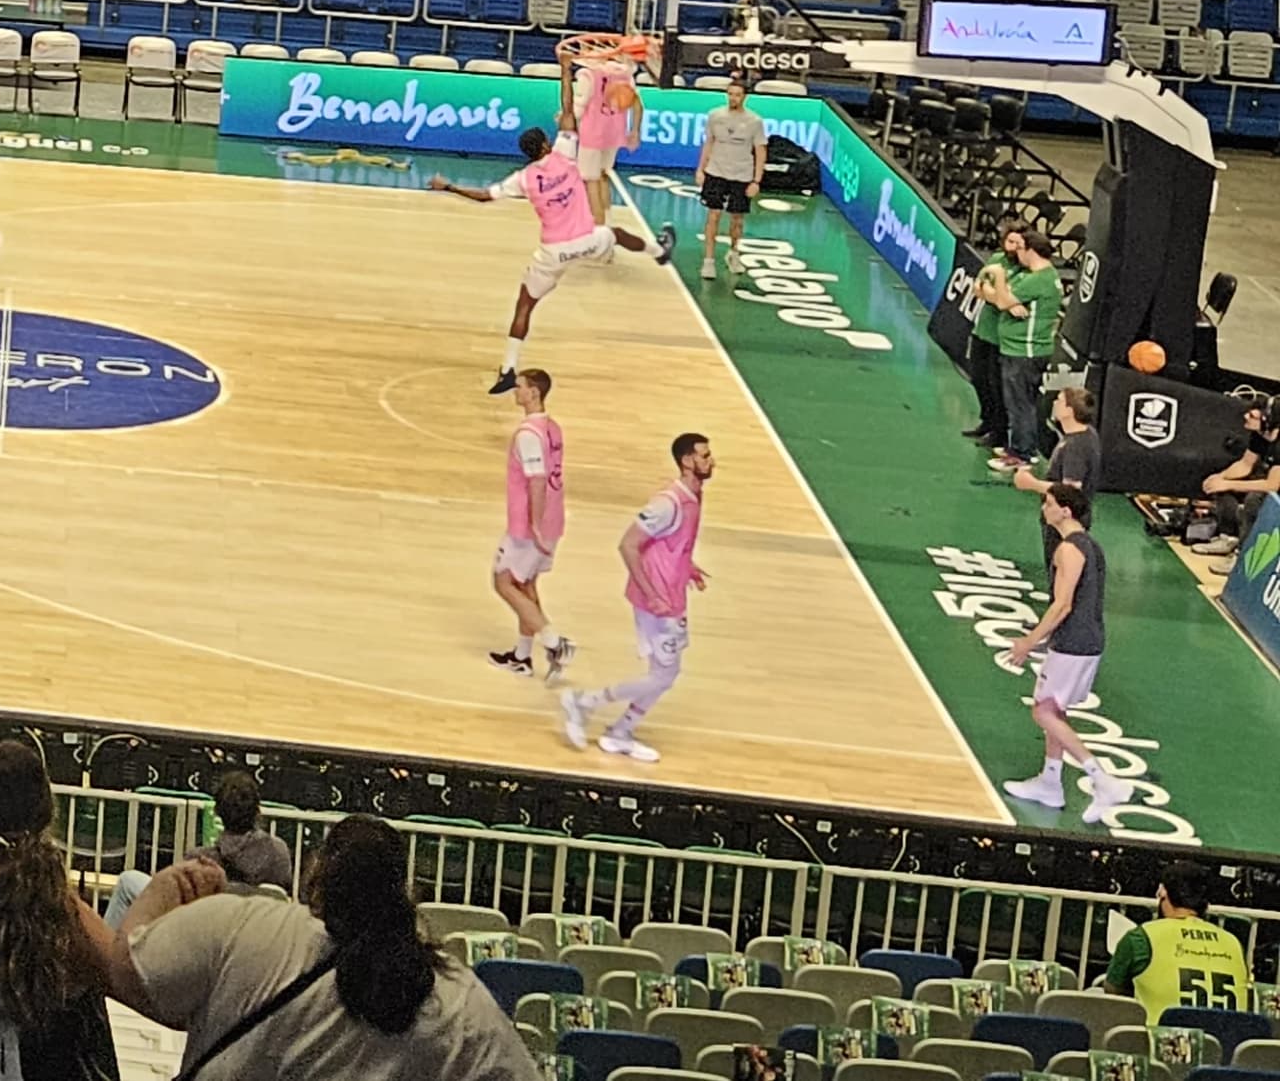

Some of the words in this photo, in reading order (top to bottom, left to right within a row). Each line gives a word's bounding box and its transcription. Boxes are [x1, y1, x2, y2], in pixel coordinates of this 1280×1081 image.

[707, 48, 811, 70] endesa
[1181, 928, 1220, 943] PERRY
[1178, 967, 1237, 1012] 55
